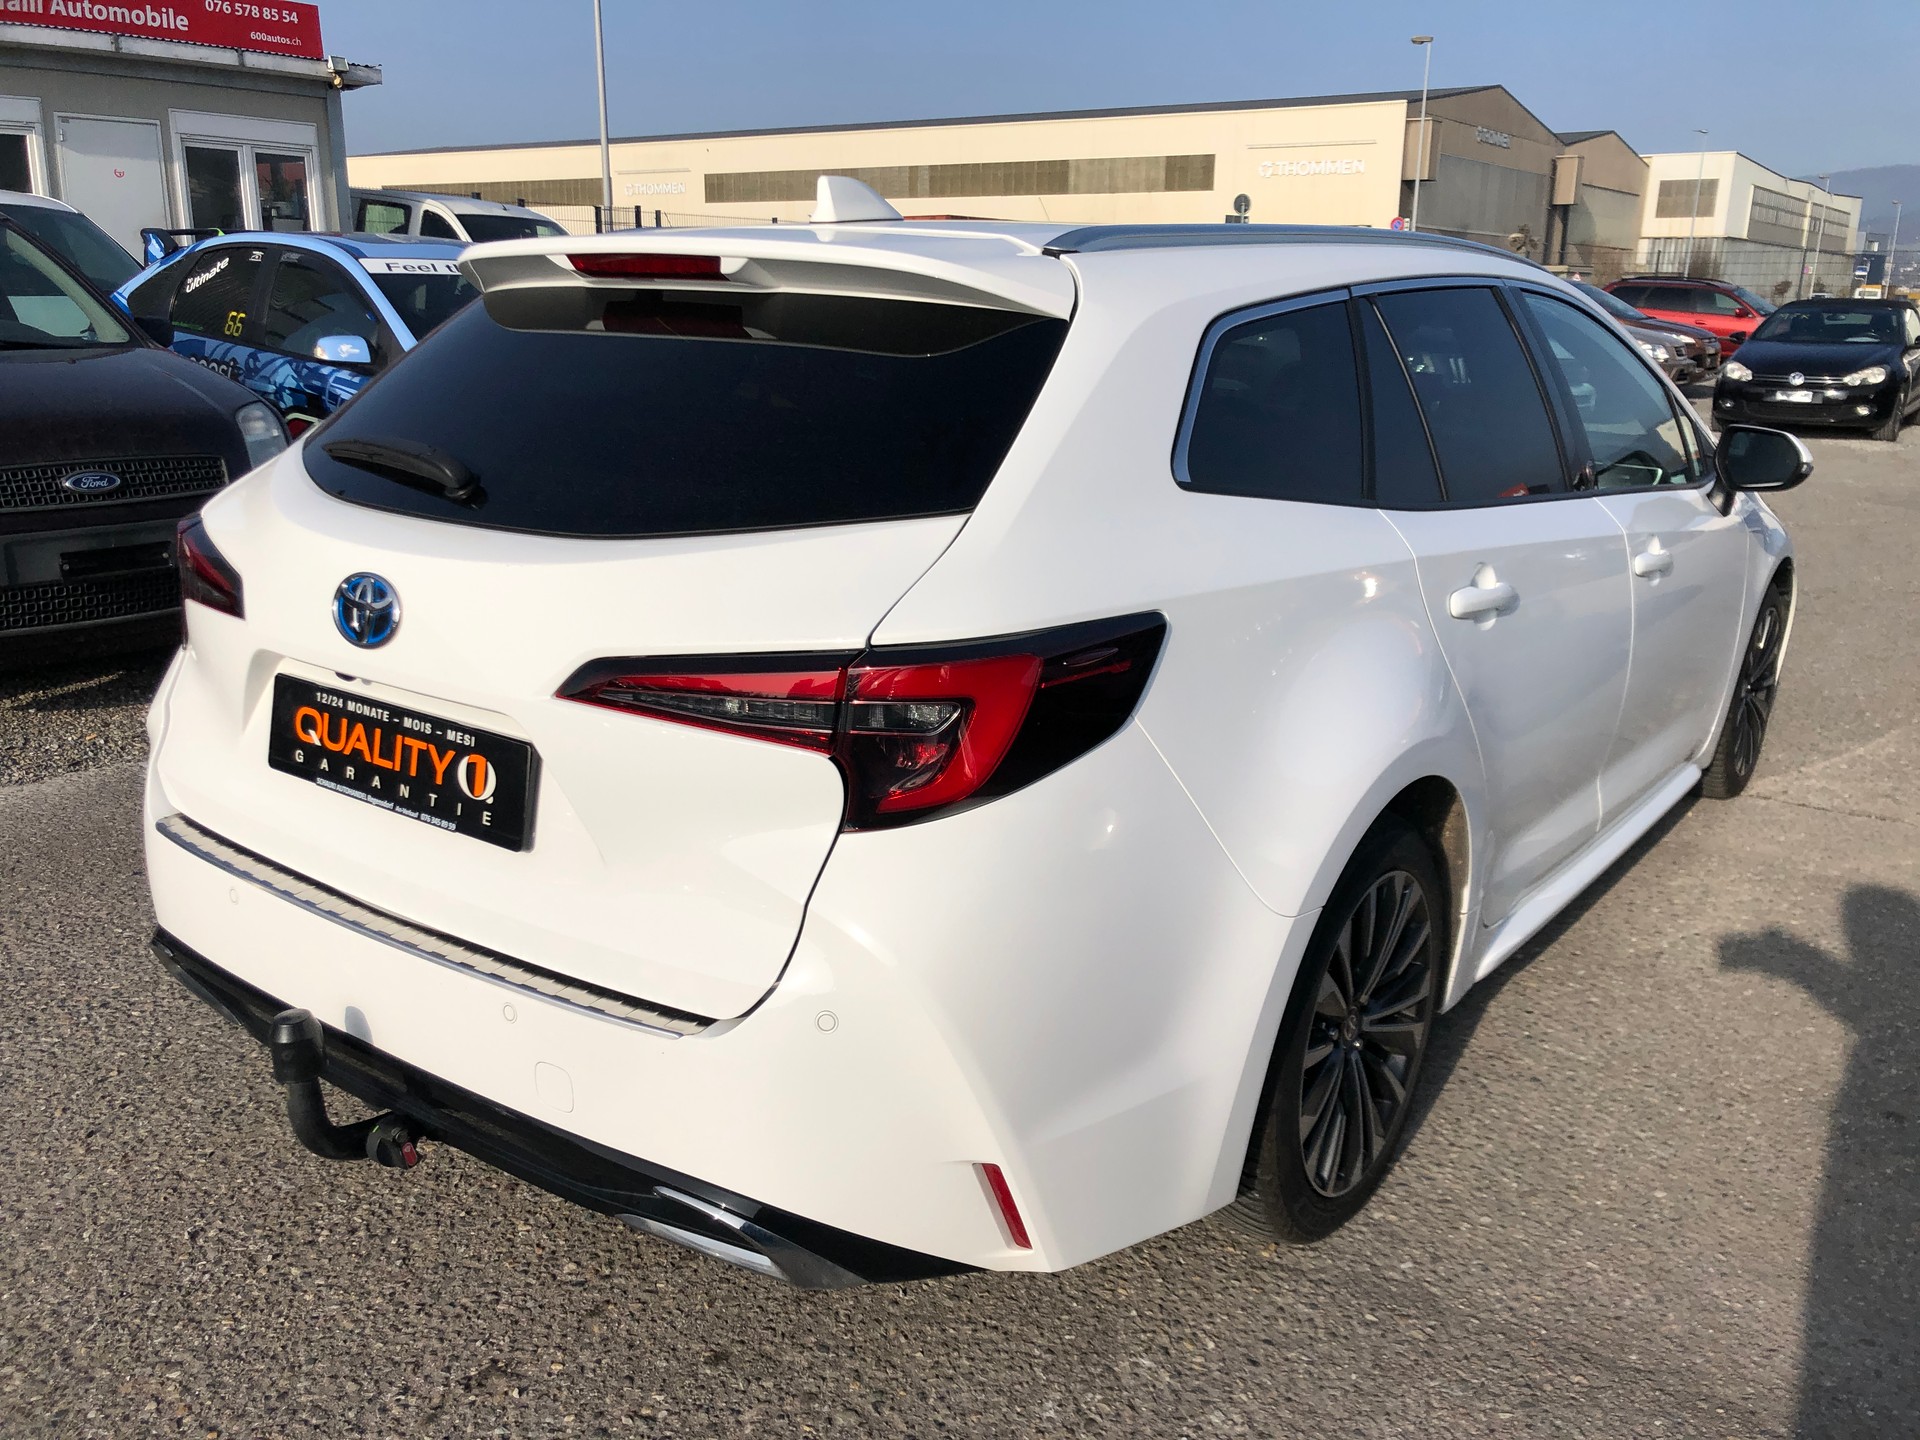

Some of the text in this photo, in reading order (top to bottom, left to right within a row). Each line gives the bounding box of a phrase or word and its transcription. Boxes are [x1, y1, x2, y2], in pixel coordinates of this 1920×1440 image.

[50, 0, 189, 31] Automobile
[205, 0, 298, 24] 076 578 85 54
[250, 31, 302, 46] 600autos.ch
[1276, 159, 1365, 176] THOMMEN
[635, 182, 686, 195] THOMMEN
[186, 257, 230, 293] ultimate
[385, 262, 438, 273] Feel
[225, 311, 246, 337] 66
[80, 475, 109, 488] Ford
[316, 692, 343, 708] 12/24
[347, 700, 390, 722] MONATE
[403, 716, 432, 735] MOIS
[446, 728, 476, 748] MESI
[294, 706, 456, 785] QUALITY
